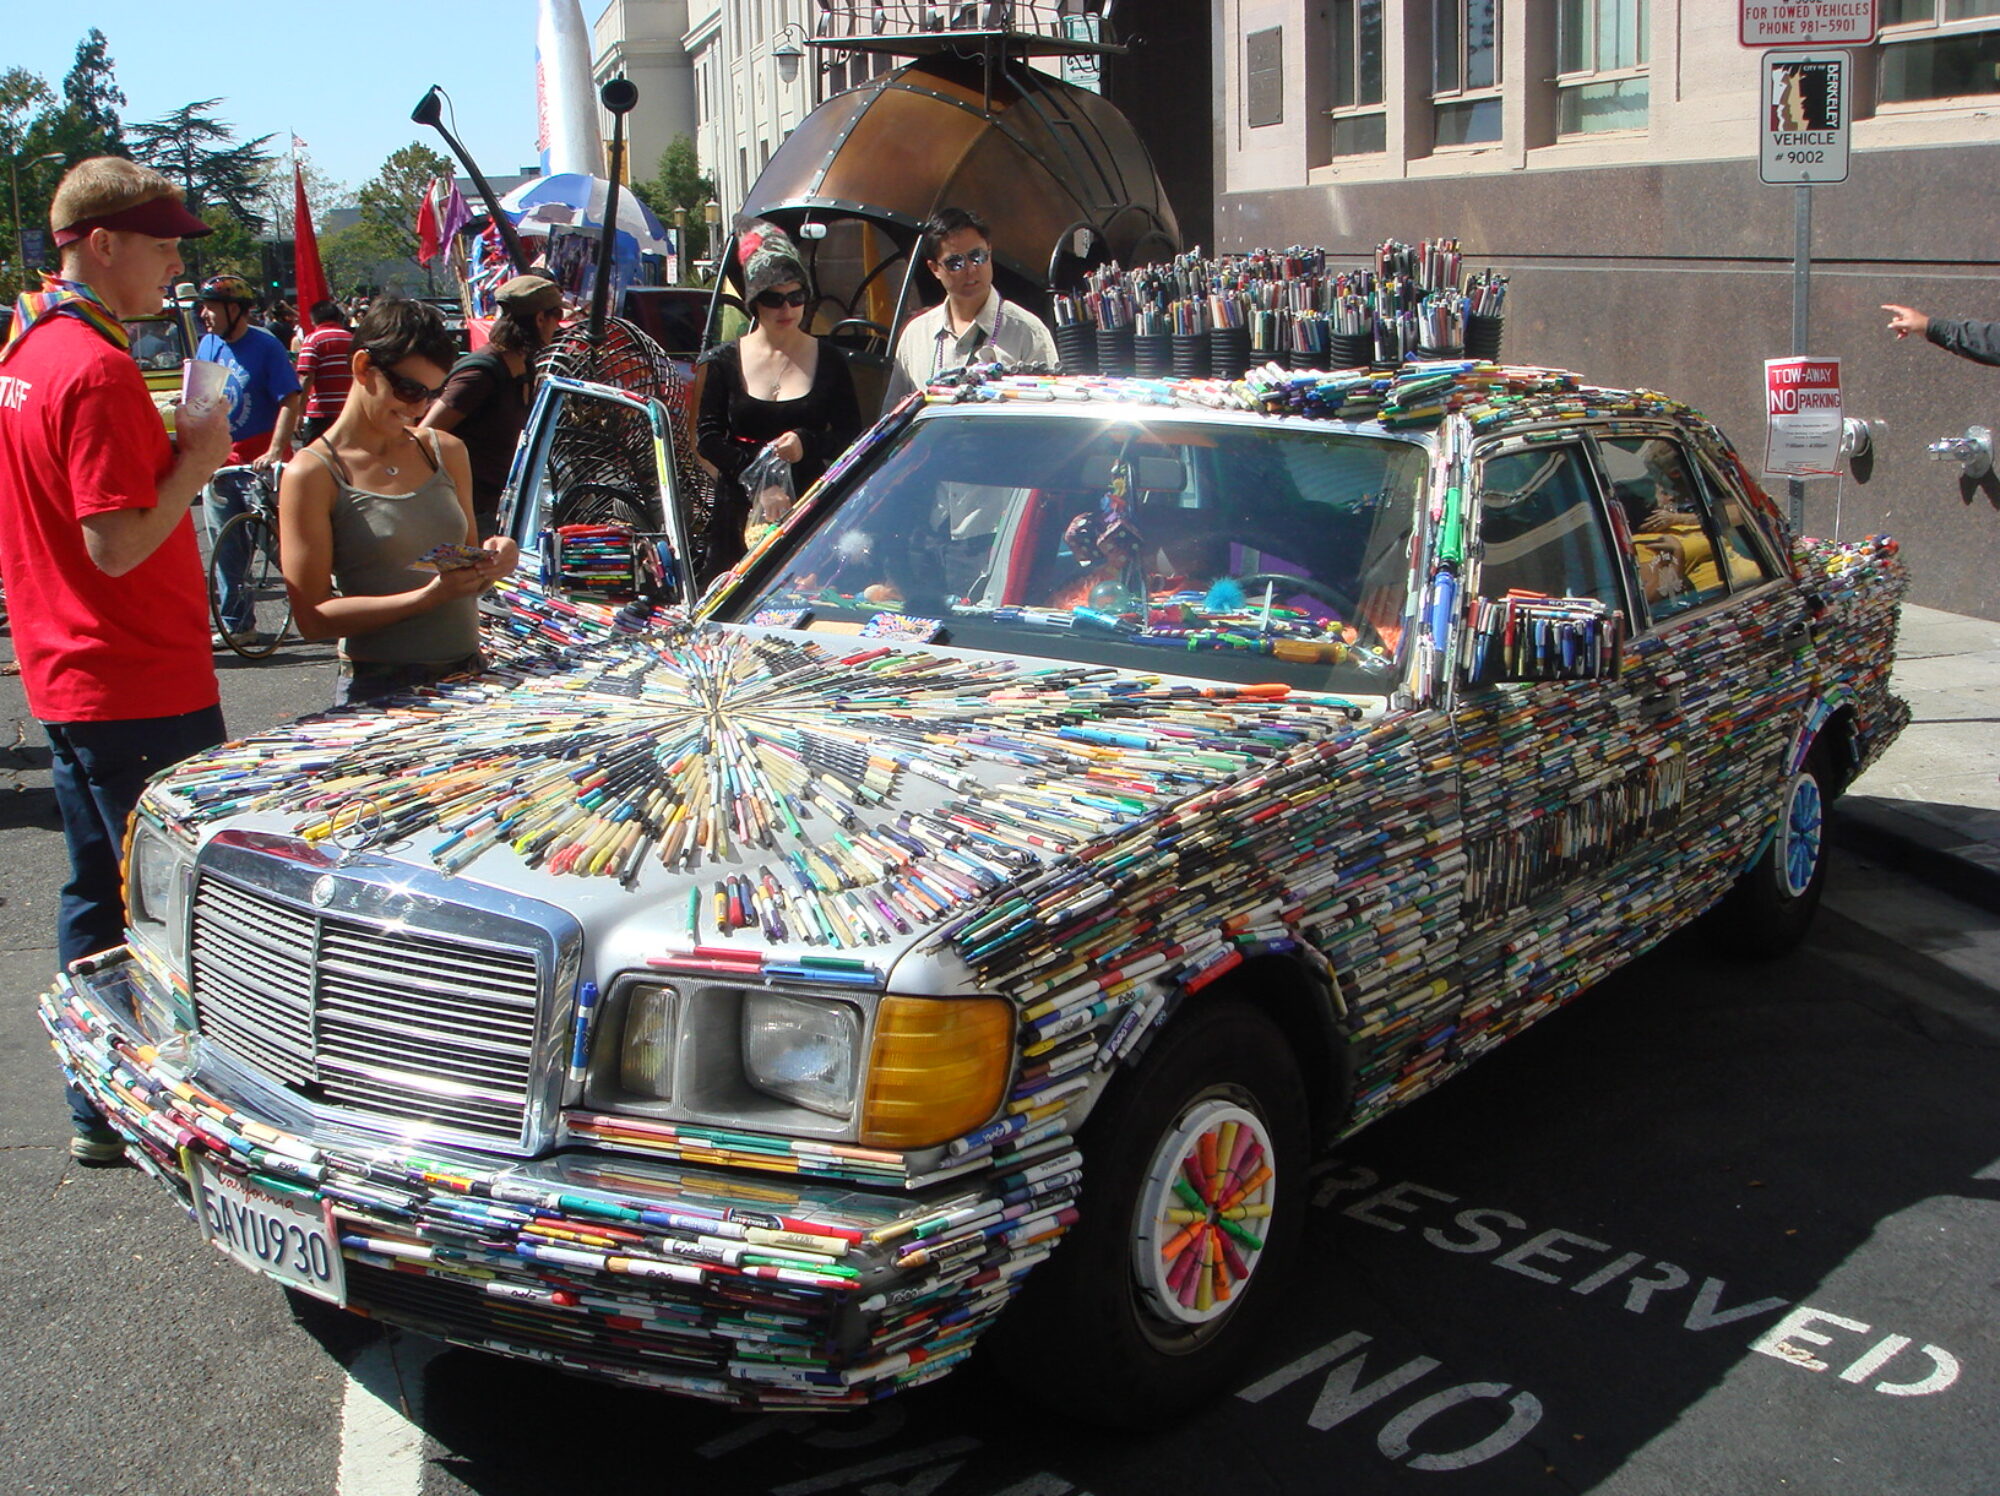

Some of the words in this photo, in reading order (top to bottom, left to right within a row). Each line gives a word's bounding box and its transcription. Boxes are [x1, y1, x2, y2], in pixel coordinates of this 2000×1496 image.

[1746, 7, 1767, 20] FOR
[1773, 5, 1810, 19] TOWED
[1815, 3, 1870, 17] VEHICLES
[1759, 21, 1795, 35] PHONE
[1799, 19, 1856, 33] 981-5901
[1826, 64, 1840, 128] BERKELEY
[1773, 132, 1836, 146] VEHICLE
[1787, 151, 1824, 164] 9002
[1772, 368, 1832, 384] TOW-AWAY
[1771, 389, 1796, 411] NO
[1799, 393, 1841, 410] PARKING
[202, 1184, 331, 1282] 5AYU930
[1305, 1161, 1963, 1398] RESERVED
[1233, 1330, 1545, 1471] NO
